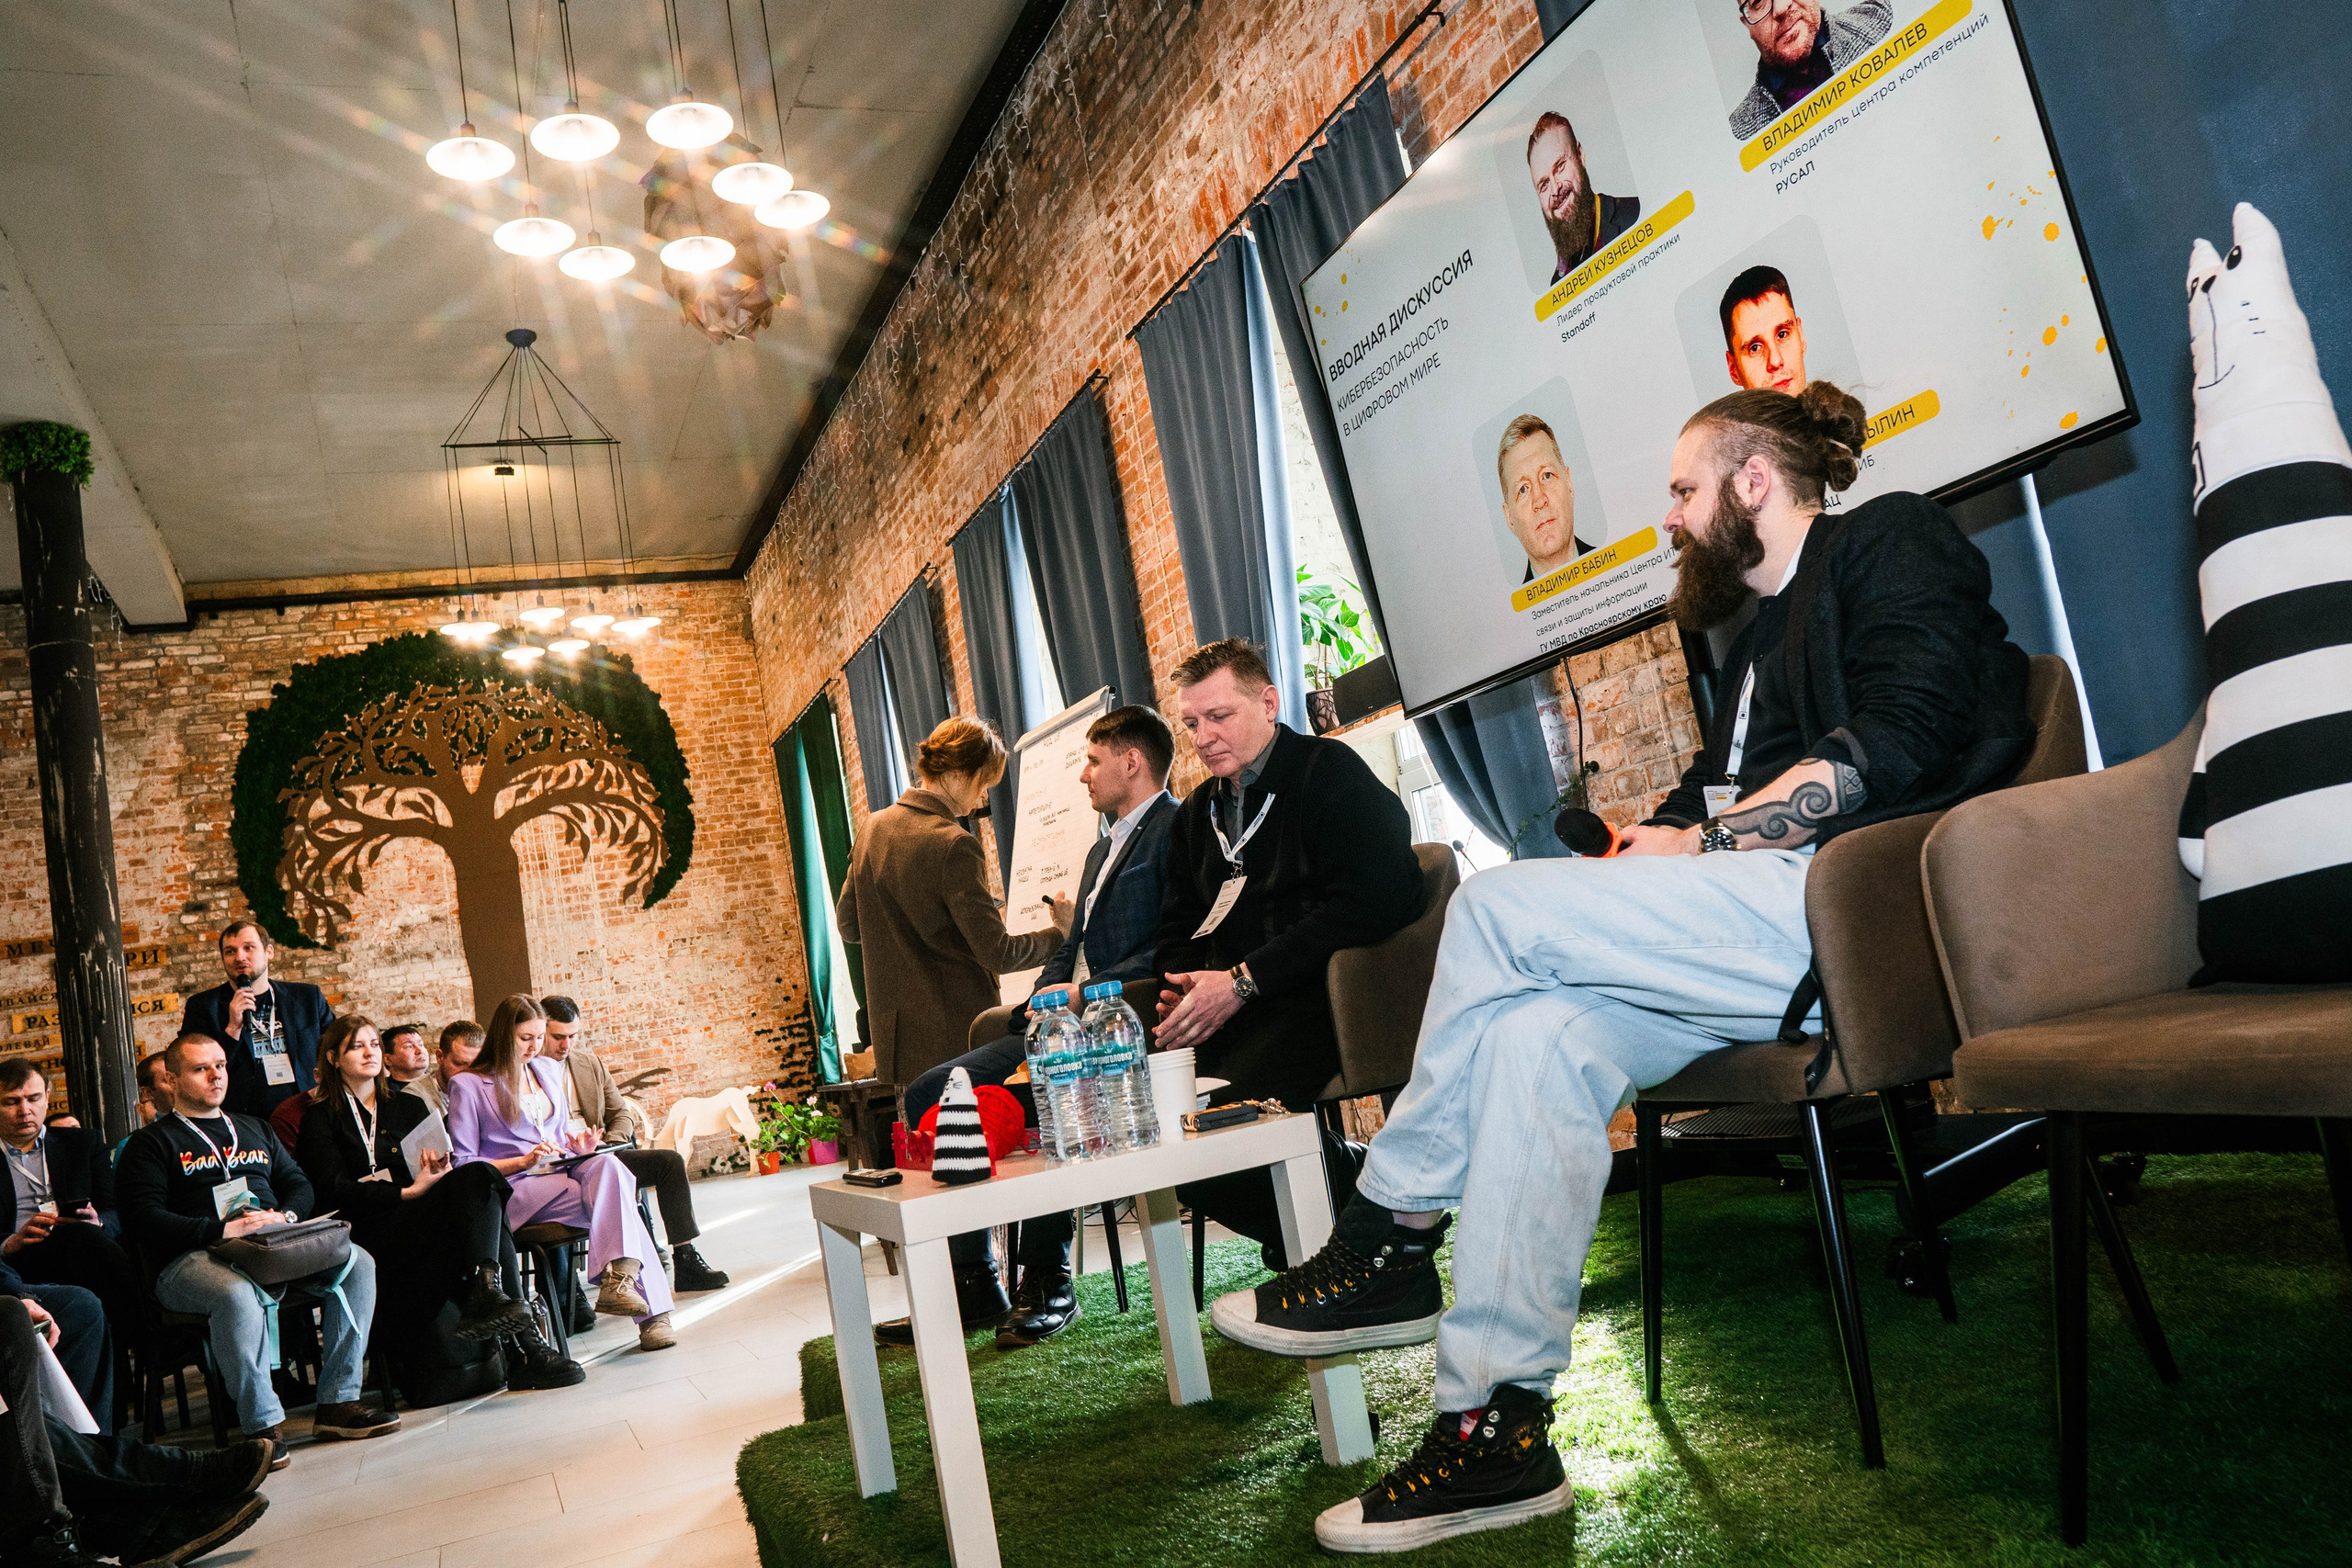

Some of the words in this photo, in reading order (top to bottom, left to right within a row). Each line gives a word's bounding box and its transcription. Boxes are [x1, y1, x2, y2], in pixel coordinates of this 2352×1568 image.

[1762, 81, 1847, 151] ВЛАДИМИР
[1849, 22, 1928, 88] КОВАЛЕВ
[1770, 116, 1849, 175] Руководитель
[1850, 80, 1896, 119] центра
[1898, 14, 1989, 85] компетенций
[1775, 160, 1815, 194] РУСАЛ
[1552, 265, 1593, 306] АНДРЕЙ
[1594, 223, 1654, 275] КУЗНЕЦОВ
[1556, 303, 1583, 326] Лидер
[1584, 263, 1637, 308] продуктовой
[1638, 233, 1680, 270] практики
[1329, 322, 1387, 381] ВВОДНАЯ
[1390, 248, 1474, 335] ДИСКУССИЯ
[1561, 311, 1597, 343] Standoff
[1337, 317, 1449, 412] КИБЕРБЕЗОПАСНОСТЬ
[1342, 423, 1351, 436] В
[1352, 378, 1409, 431] ЦИФРОВОМ
[1409, 352, 1442, 386] МИРЕ
[1526, 566, 1580, 602] ВЛАДИМИР
[1582, 548, 1617, 577] БАБИН
[1531, 592, 1579, 620] Заместитель
[1580, 570, 1630, 599] начальника
[1630, 555, 1663, 576] Центра
[1535, 622, 1557, 637] связи
[1564, 606, 1595, 626] защиты
[1596, 581, 1648, 611] информации
[1539, 642, 1550, 654] ГУ
[1549, 635, 1567, 649] МВД
[1568, 630, 1577, 641] по
[1578, 604, 1642, 636] Красноярскому
[1643, 593, 1668, 611] краю
